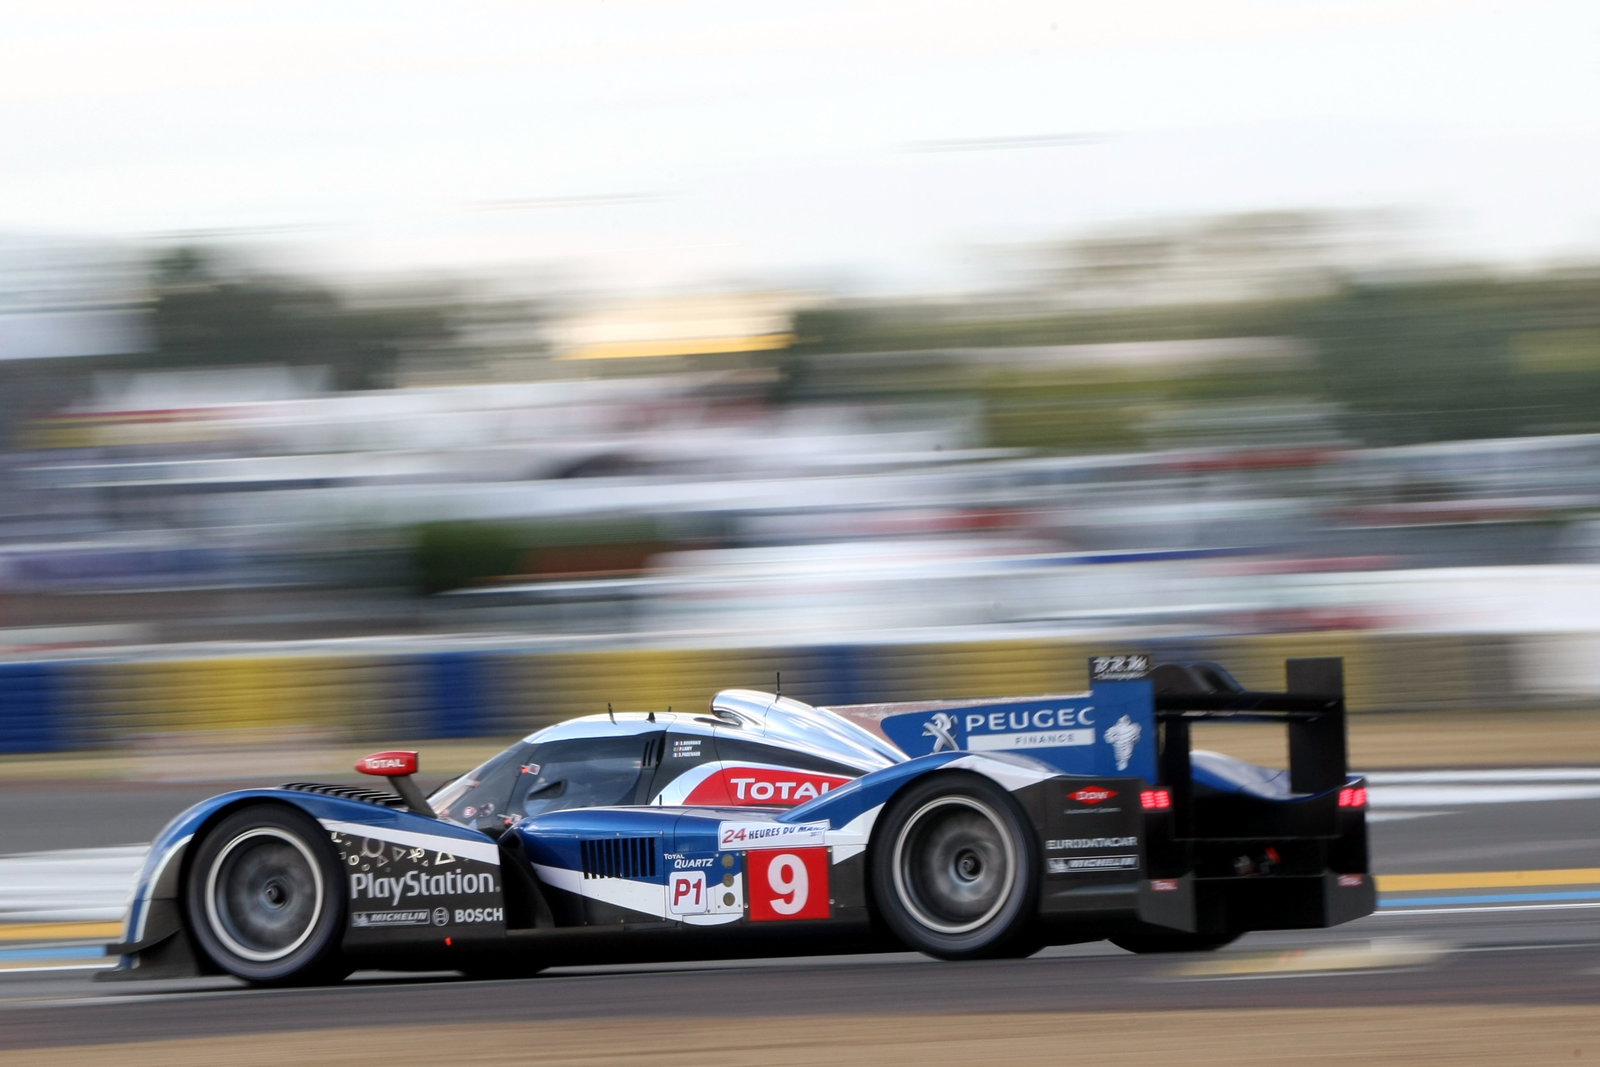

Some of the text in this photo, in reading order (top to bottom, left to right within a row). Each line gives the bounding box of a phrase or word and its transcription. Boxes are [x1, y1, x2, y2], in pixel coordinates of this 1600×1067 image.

[1015, 733, 1075, 744] FINANCE
[364, 758, 405, 769] TOTAL
[722, 828, 747, 844] 24
[748, 828, 780, 840] HEURES
[783, 826, 796, 835] DU
[674, 858, 714, 869] QUARTZ
[351, 868, 494, 906] PlayStation
[767, 853, 809, 915] 9
[673, 878, 702, 906] P1
[371, 911, 428, 922] MICHELIN
[454, 908, 503, 923] BOSCH
